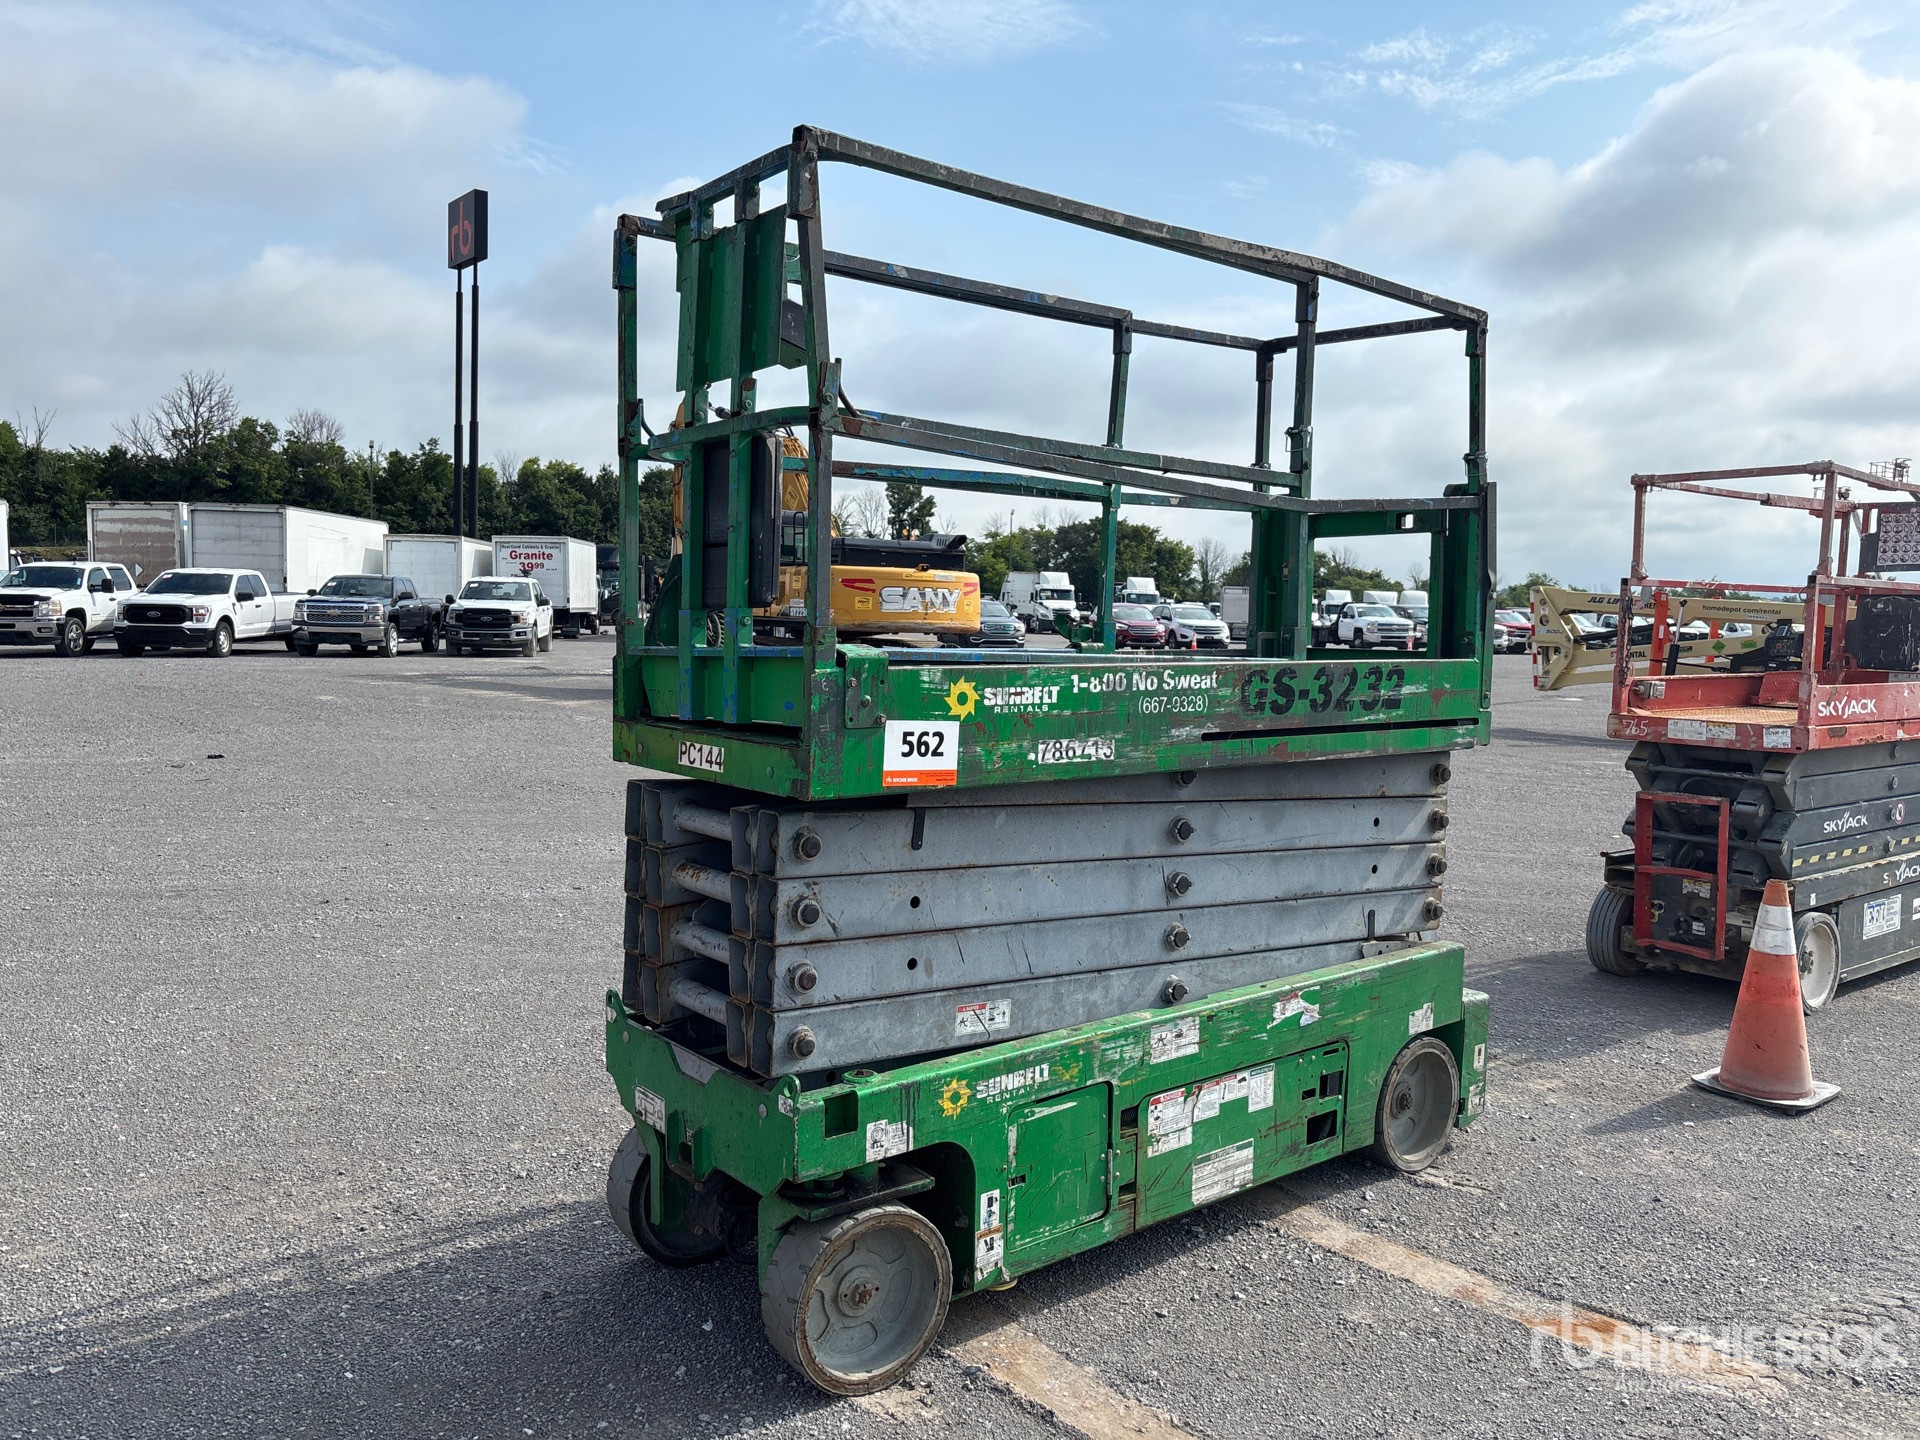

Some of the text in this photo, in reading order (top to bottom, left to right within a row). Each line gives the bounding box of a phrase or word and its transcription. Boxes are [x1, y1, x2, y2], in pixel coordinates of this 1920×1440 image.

[450, 201, 472, 262] rb
[509, 550, 554, 560] Granite
[879, 586, 962, 613] SANY
[1071, 669, 1218, 693] 1-800 No Sweat
[1240, 664, 1405, 716] GS-3232
[983, 686, 1060, 706] SUNBELT
[994, 704, 1049, 713] RENTALS
[1138, 694, 1209, 713] (667-9328)
[1818, 691, 1877, 719] SKYJACK
[680, 741, 723, 770] PC144
[901, 731, 945, 758] 562
[1823, 811, 1868, 834] SKYJACK
[976, 1063, 1049, 1098] SUNBELT
